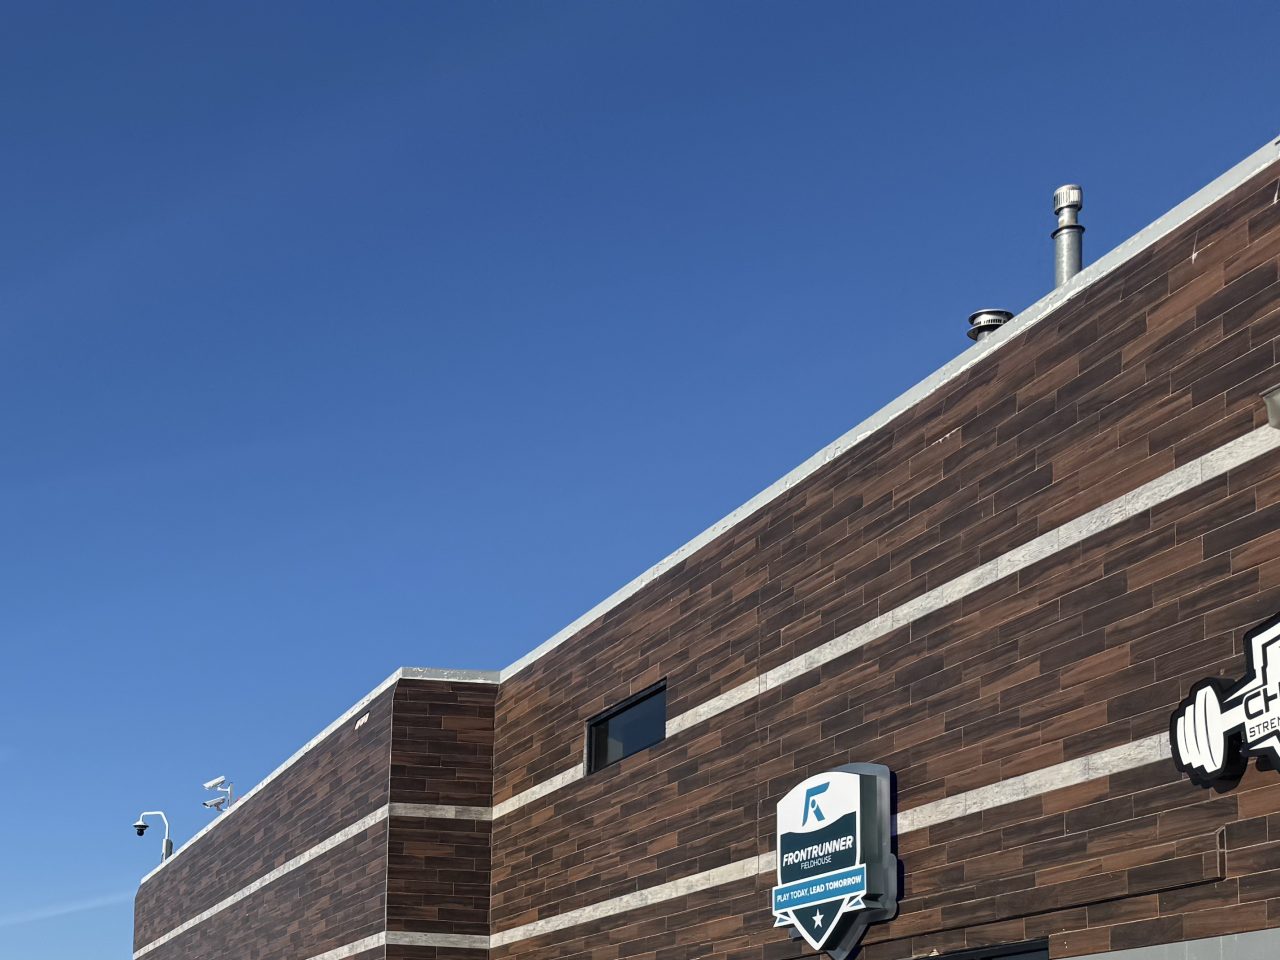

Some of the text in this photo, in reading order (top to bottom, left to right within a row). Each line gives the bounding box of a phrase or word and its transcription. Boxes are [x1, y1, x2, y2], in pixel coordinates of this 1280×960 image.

[782, 835, 854, 867] FRONTRUNNER
[800, 854, 832, 870] FIELDHOUSE
[776, 875, 862, 903] PLAY TODAY, LEAD TOMORROW
